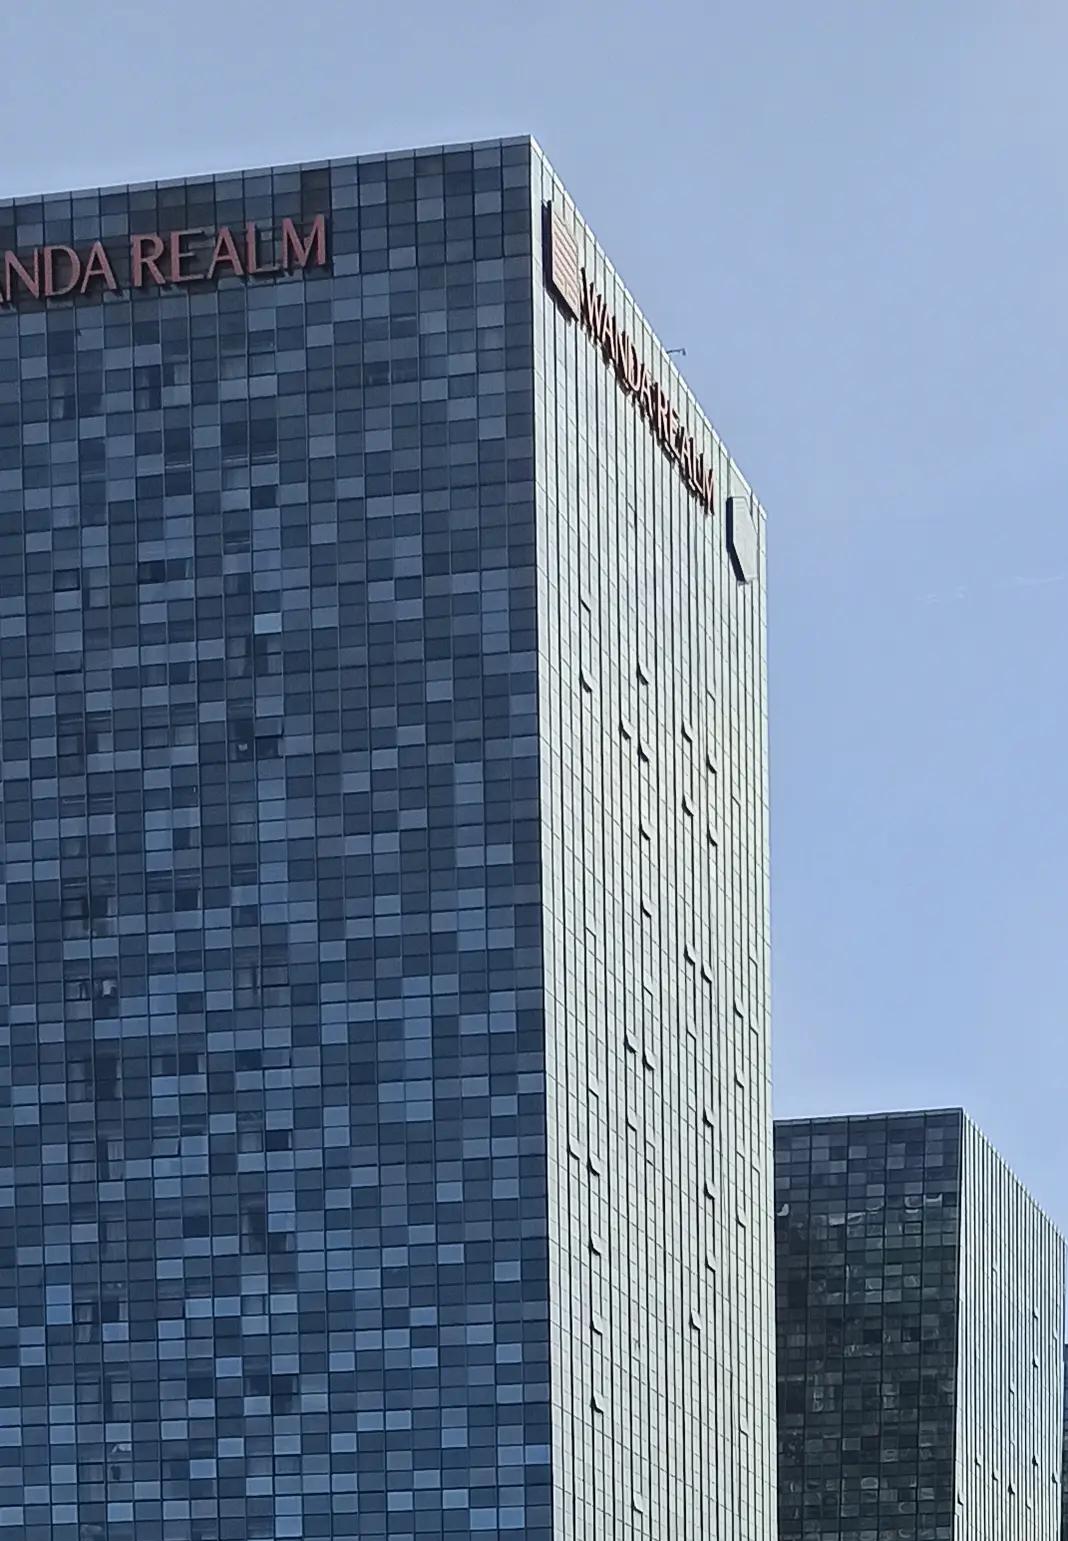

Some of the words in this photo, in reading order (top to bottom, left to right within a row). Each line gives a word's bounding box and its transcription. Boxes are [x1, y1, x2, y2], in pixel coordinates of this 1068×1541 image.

[0, 240, 118, 302] NDA
[130, 213, 326, 288] REALM
[579, 267, 657, 419] WANDA
[654, 382, 715, 516] REALM
